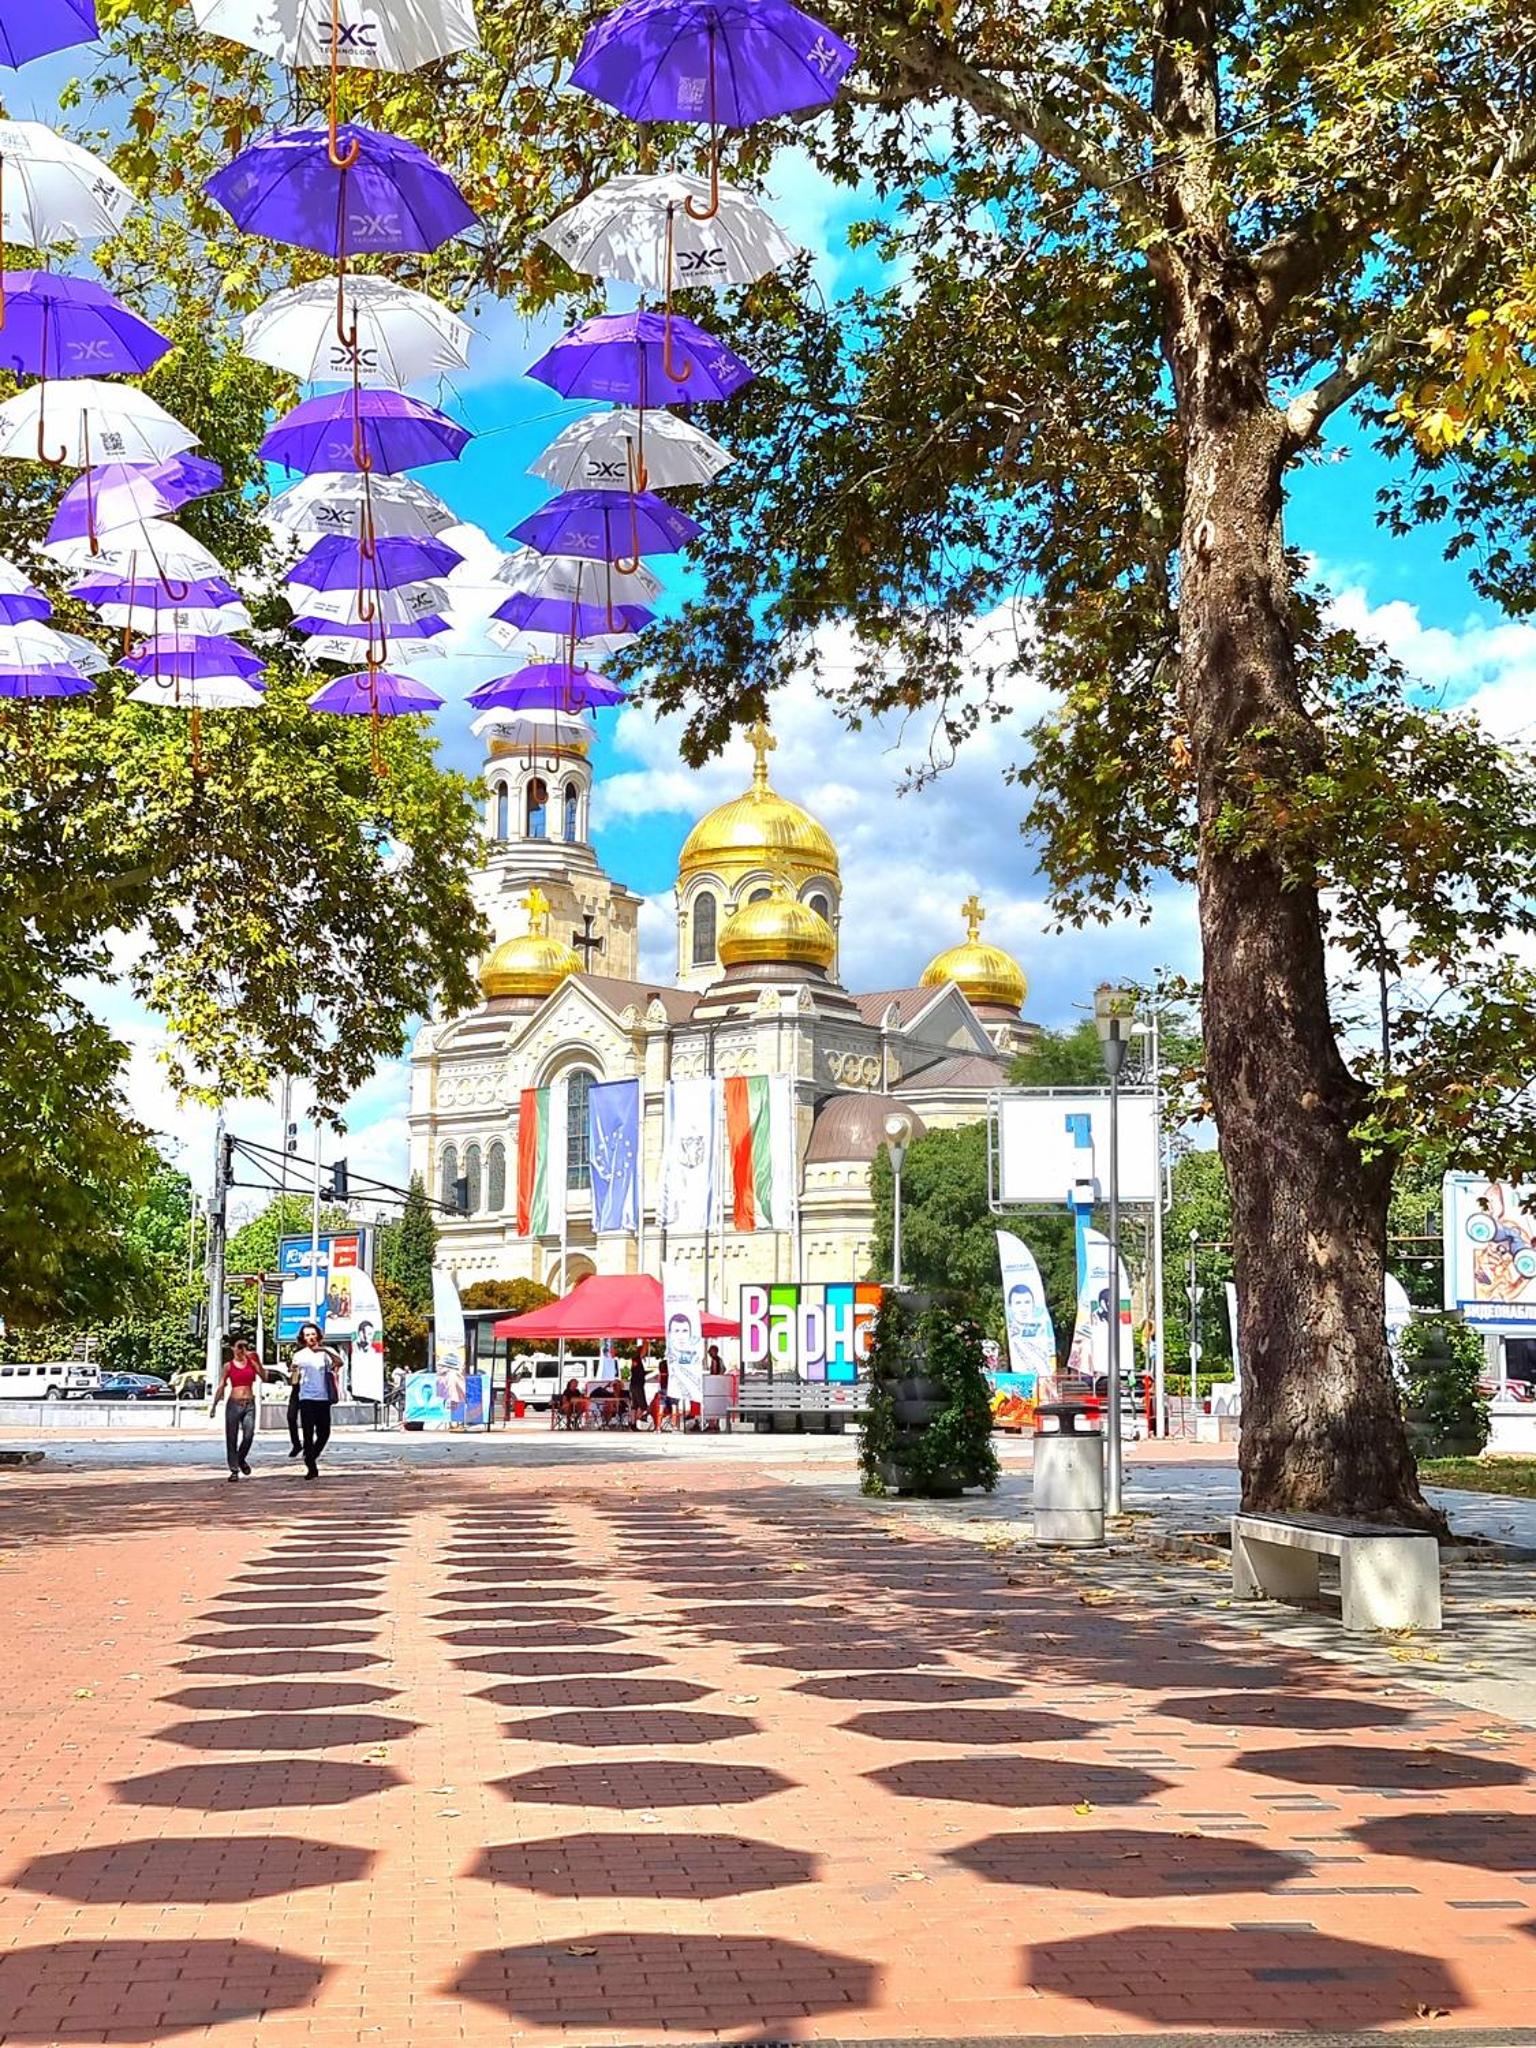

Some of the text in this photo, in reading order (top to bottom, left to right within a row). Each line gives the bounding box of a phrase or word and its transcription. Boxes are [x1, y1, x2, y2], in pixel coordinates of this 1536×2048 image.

[317, 21, 377, 47] DXC
[348, 214, 402, 236] DXC
[676, 248, 727, 271] DXC
[330, 346, 377, 366] DXC
[330, 366, 377, 374] TECHNLOGY
[587, 461, 627, 477] DXC
[316, 507, 356, 524] DXC
